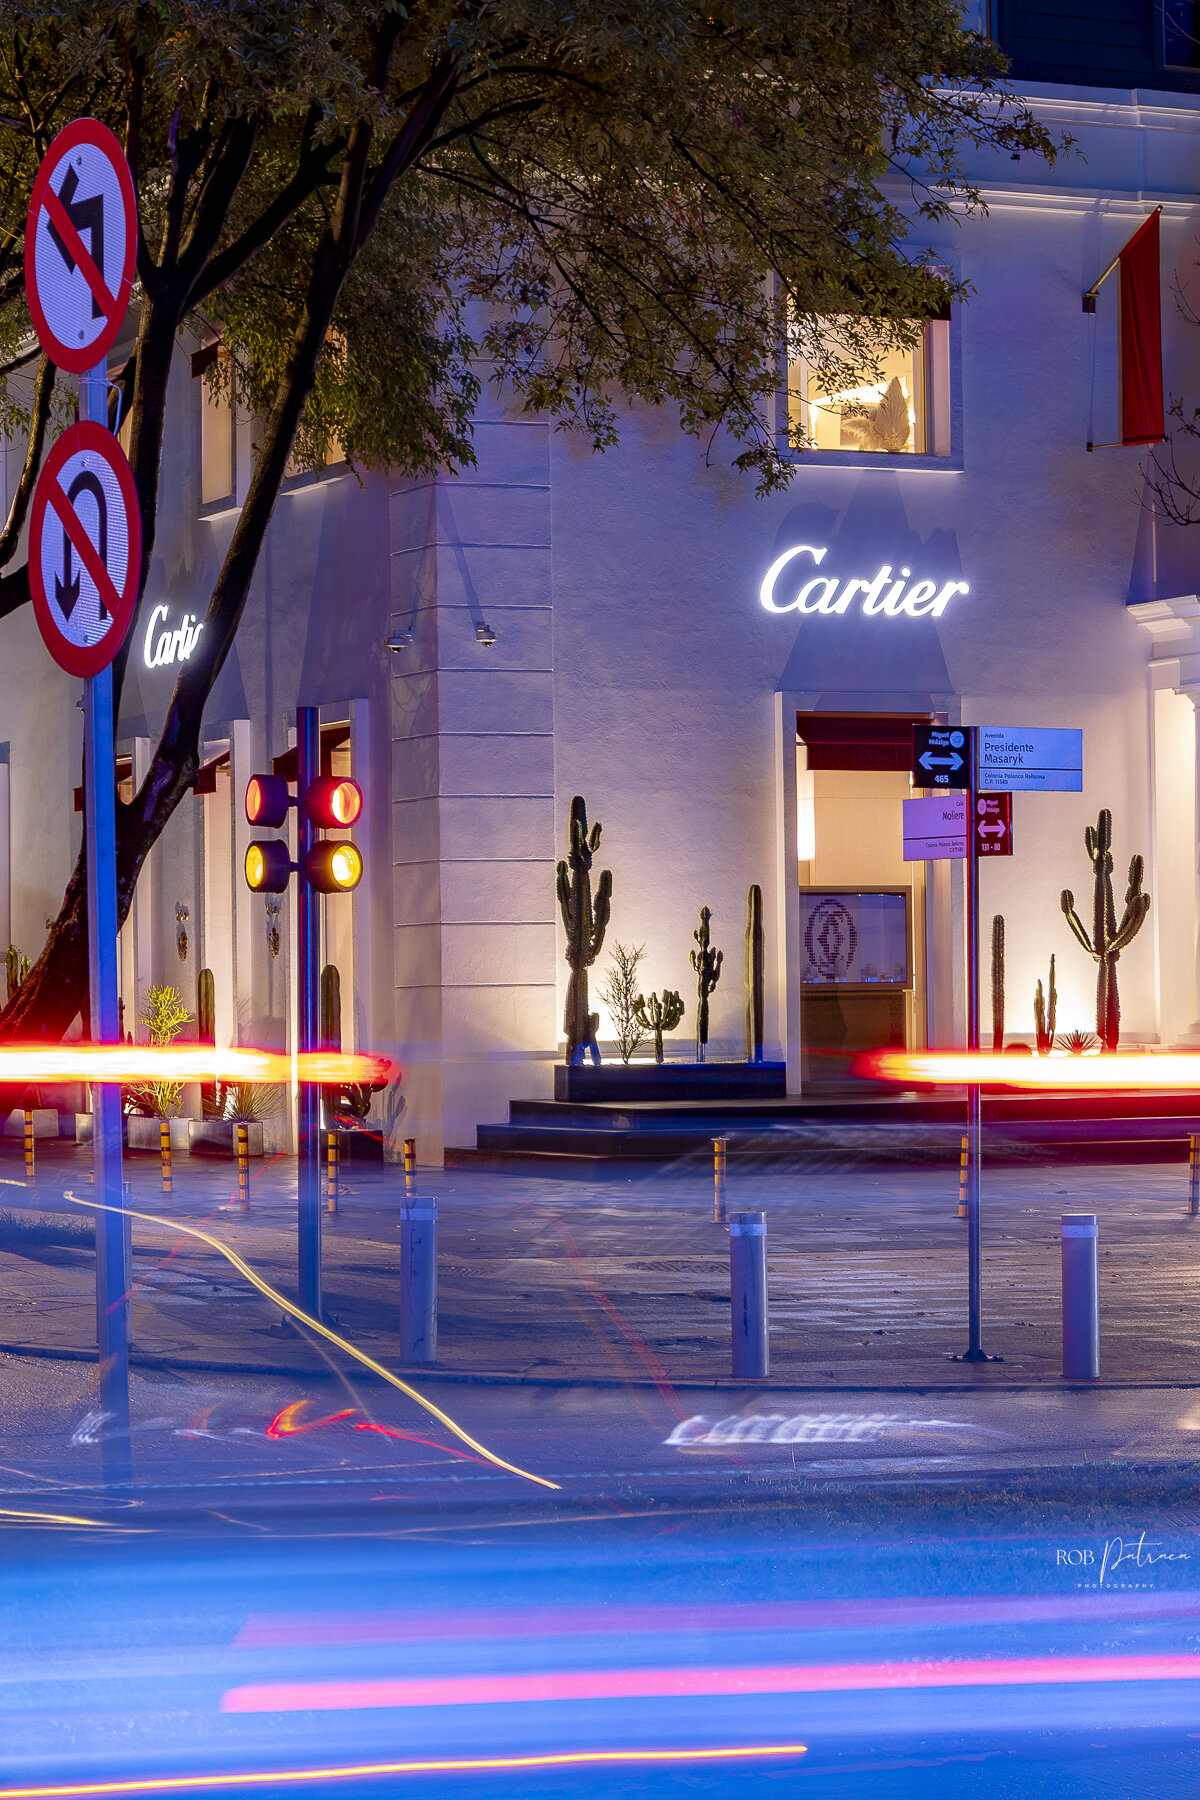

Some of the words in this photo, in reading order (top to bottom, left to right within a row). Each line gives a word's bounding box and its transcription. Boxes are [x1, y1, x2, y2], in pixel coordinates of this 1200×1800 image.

[759, 544, 970, 617] Cartier
[984, 742, 1035, 752] Presidente
[984, 753, 1024, 766] Masaryk
[934, 774, 949, 783] 465
[942, 809, 965, 821] Moliere
